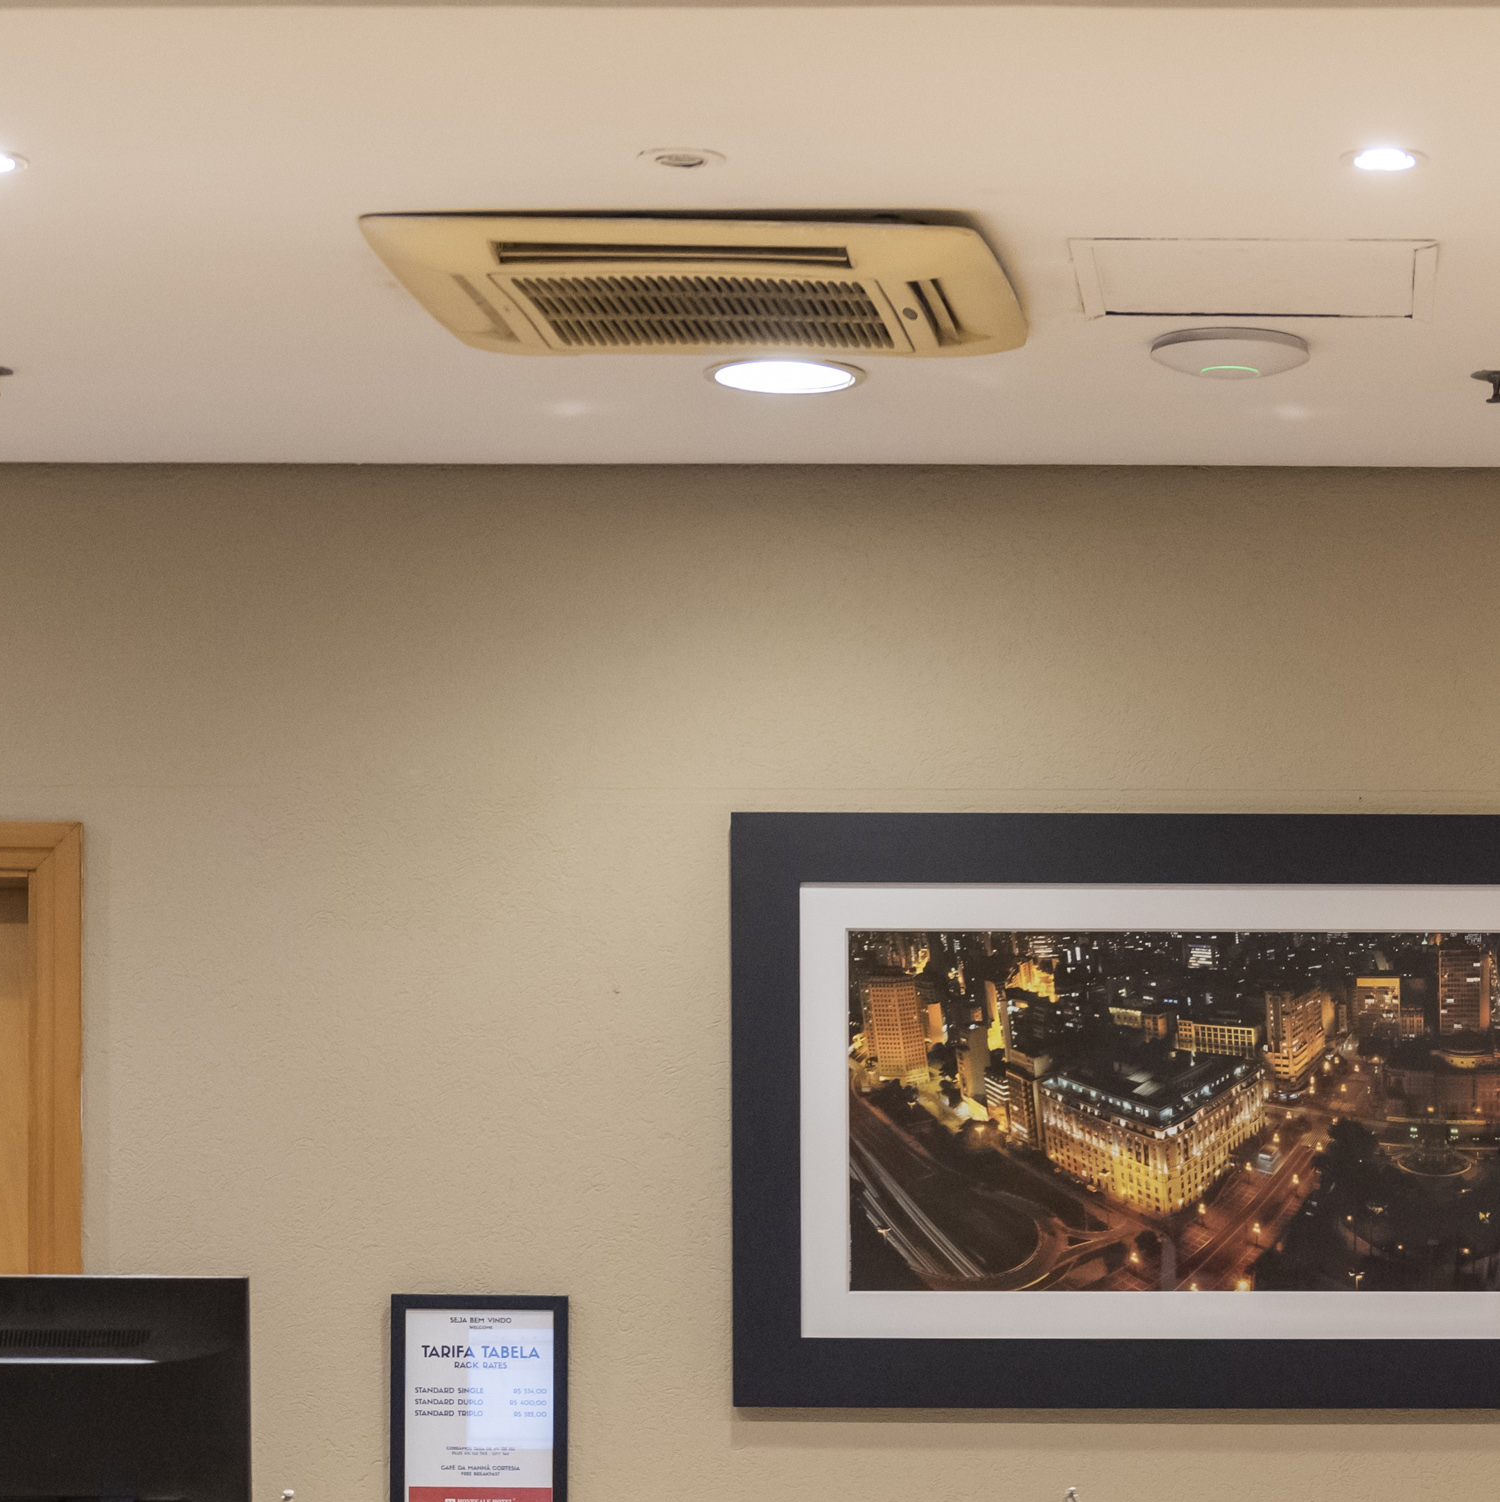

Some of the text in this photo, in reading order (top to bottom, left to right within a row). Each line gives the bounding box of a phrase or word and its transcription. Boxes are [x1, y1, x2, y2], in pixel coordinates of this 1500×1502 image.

[421, 1345, 541, 1359] TARIFA TABELA
[454, 1361, 508, 1370] RACK RATES
[414, 1398, 455, 1406] STANDARD
